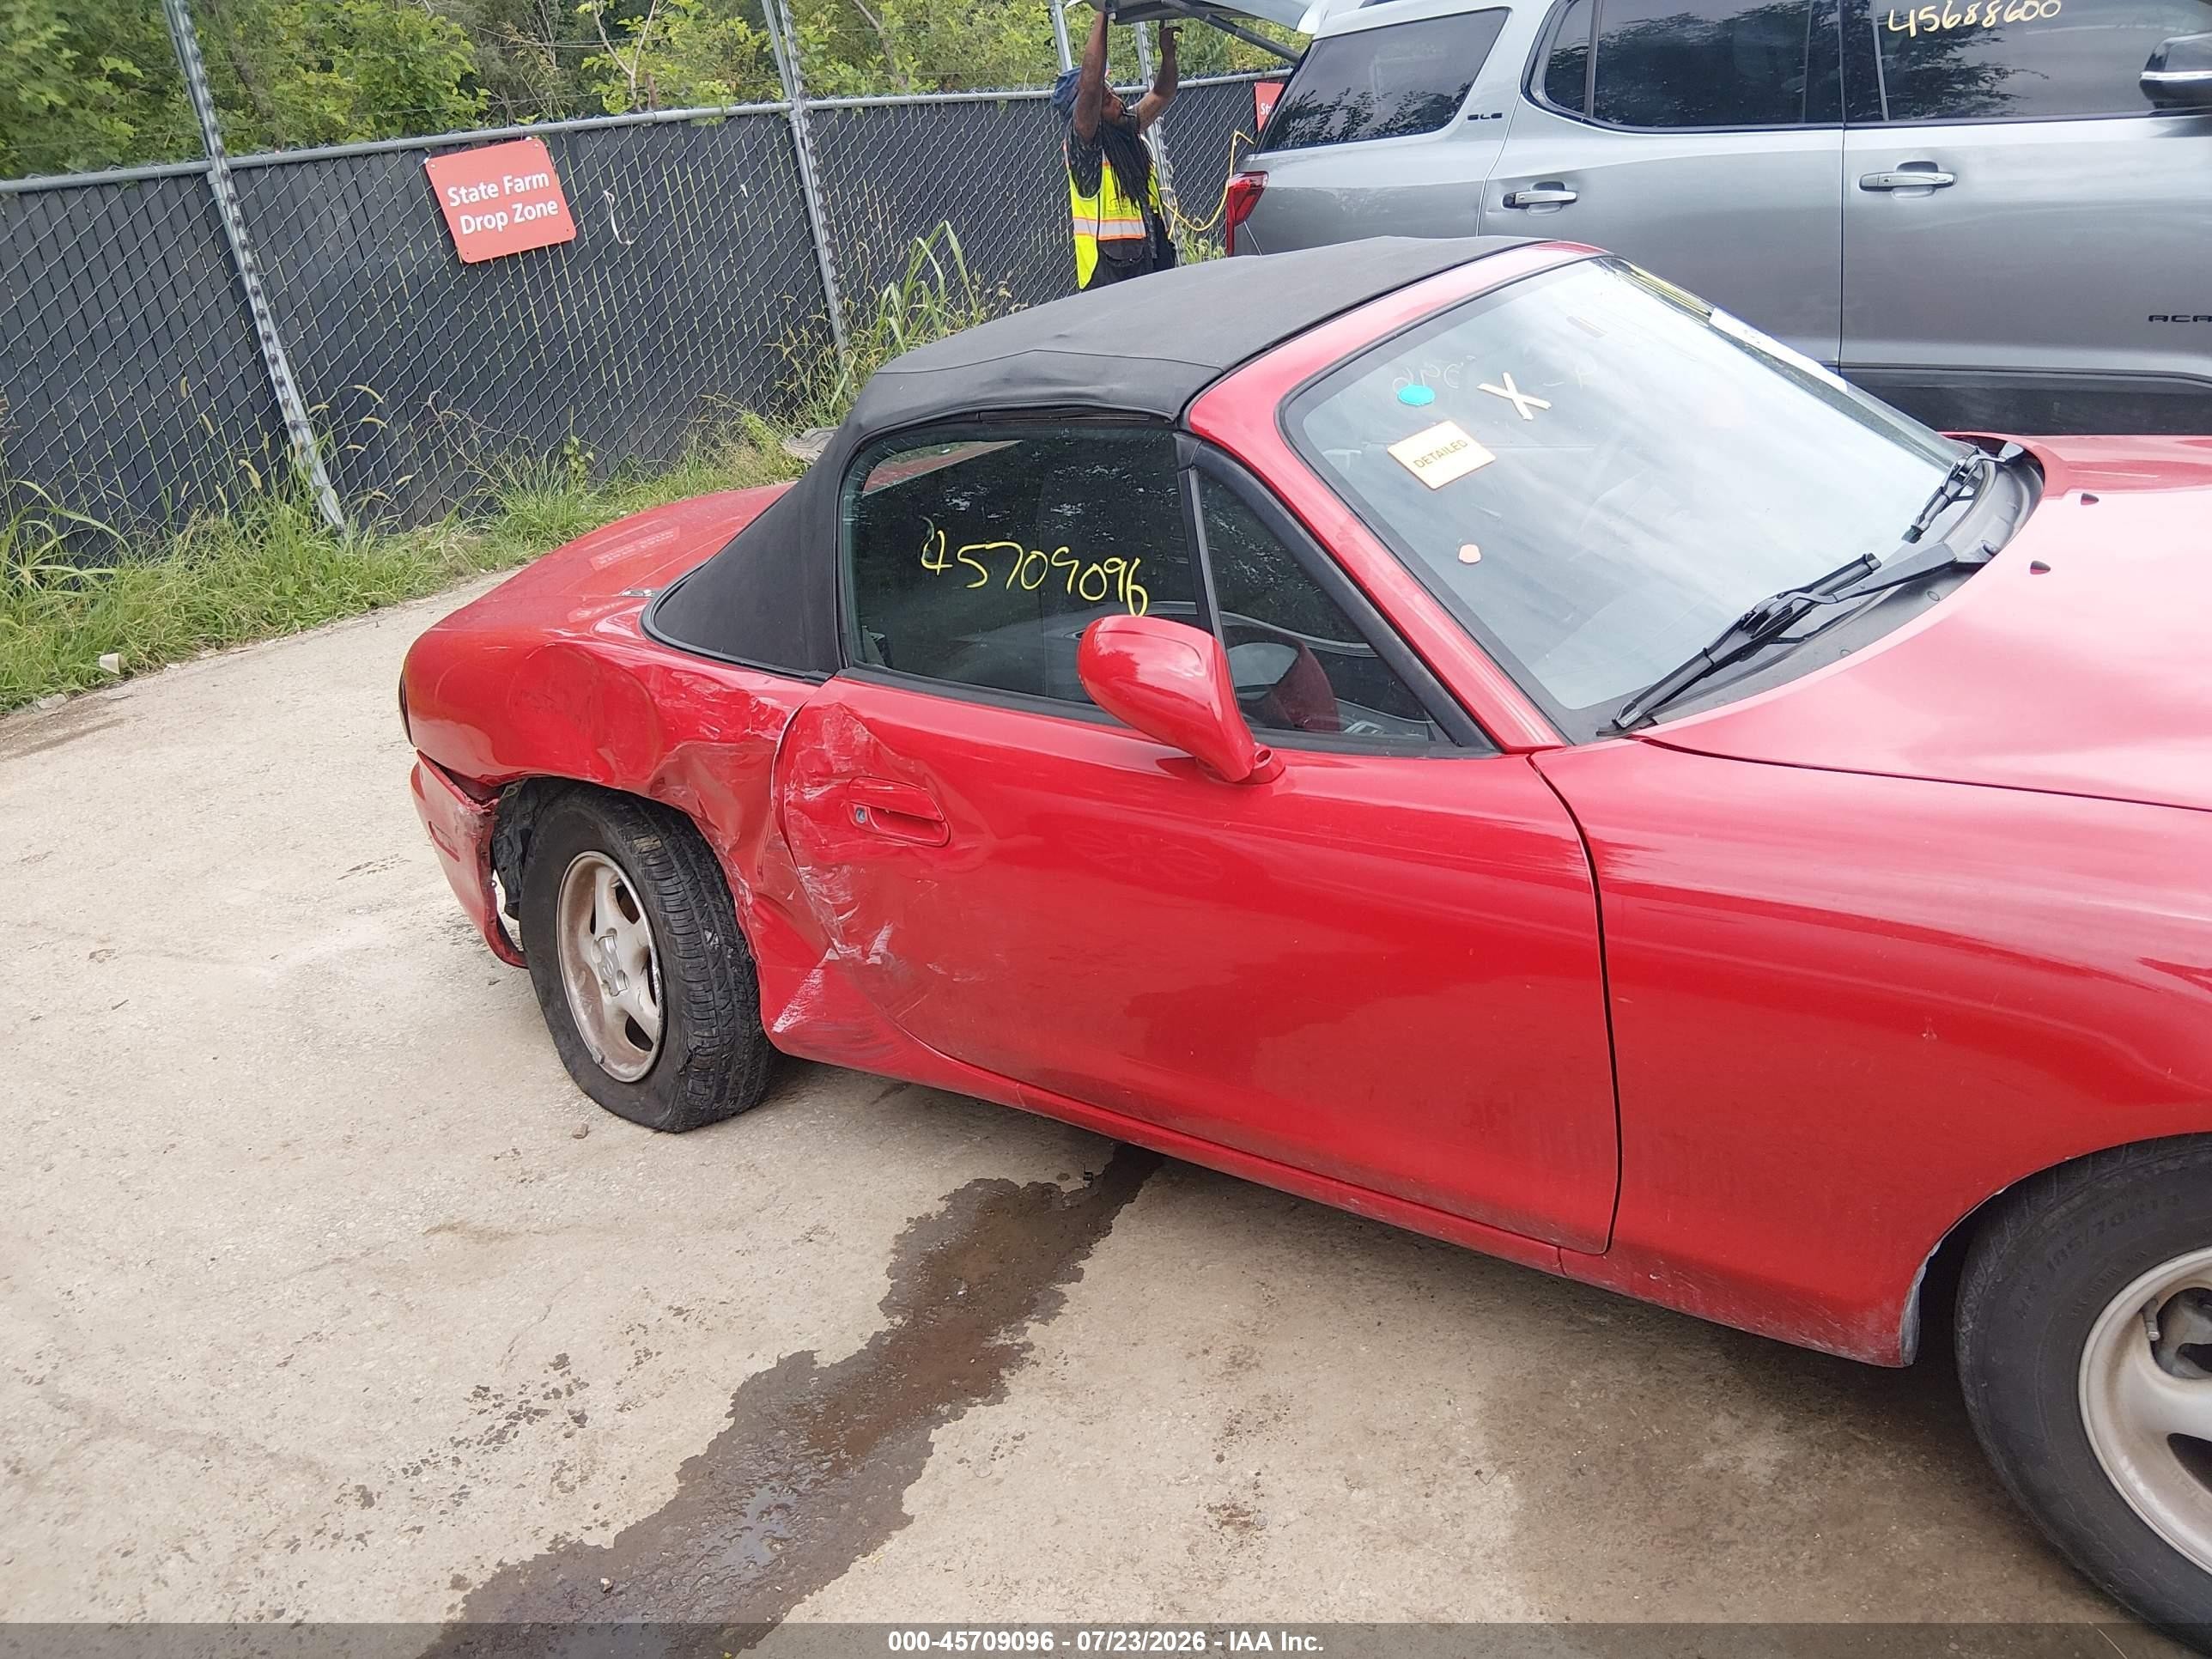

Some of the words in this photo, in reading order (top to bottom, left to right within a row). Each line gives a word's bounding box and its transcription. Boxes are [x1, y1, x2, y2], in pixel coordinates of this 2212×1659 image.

[1888, 0, 2062, 38] 45688600
[447, 181, 499, 207] State
[502, 172, 550, 196] Farm
[459, 210, 509, 234] Drop
[512, 199, 558, 224] Zone
[1413, 439, 1469, 469] DETAILED
[920, 516, 1149, 617] 45709096
